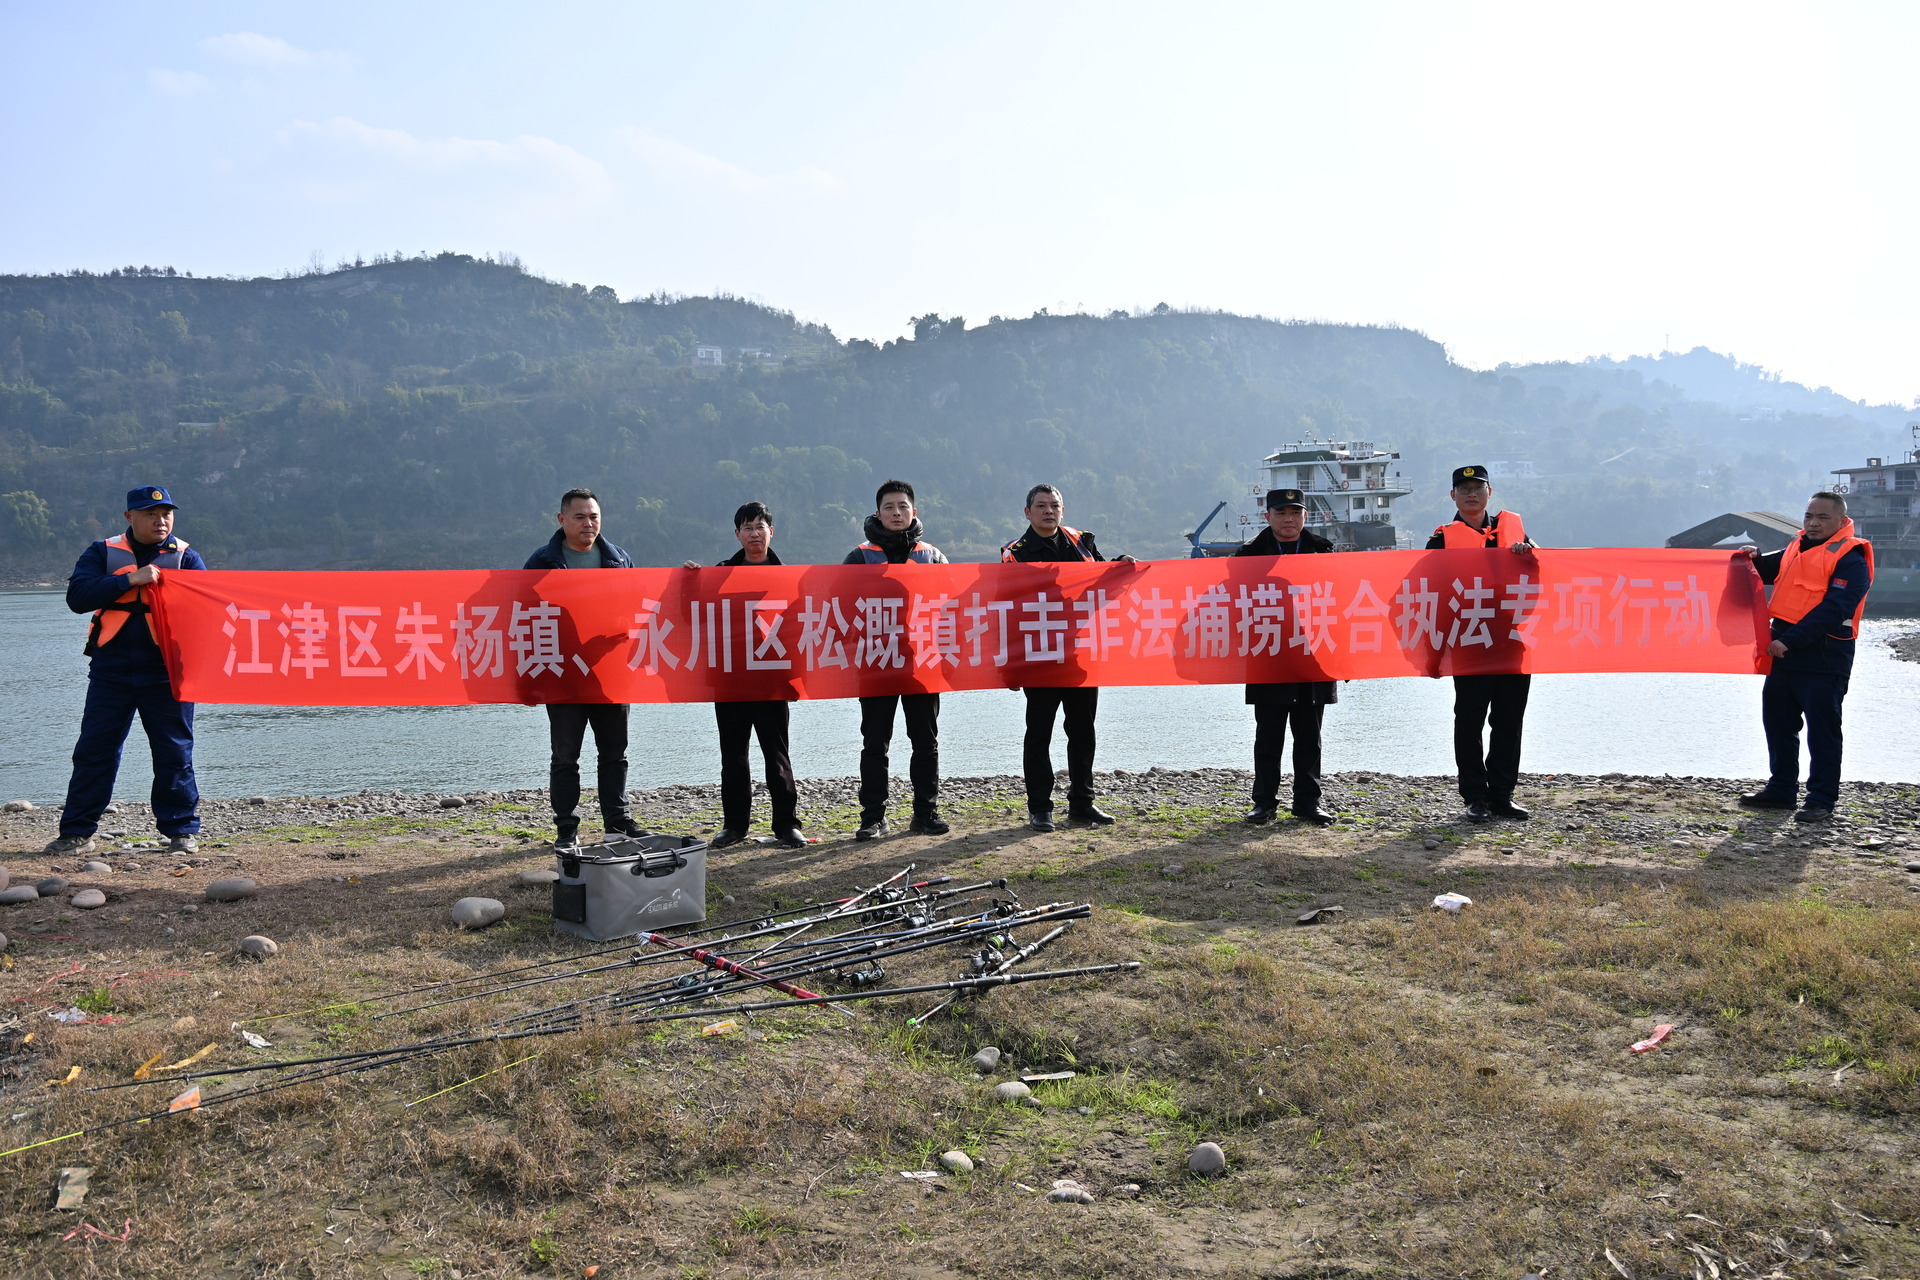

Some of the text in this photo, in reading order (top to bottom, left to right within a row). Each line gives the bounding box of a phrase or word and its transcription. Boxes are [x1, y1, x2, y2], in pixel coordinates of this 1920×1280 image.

[222, 574, 1712, 680] 江津区朱杨镇、永川区松溉镇打击非法捕捞联合执法专项行动
